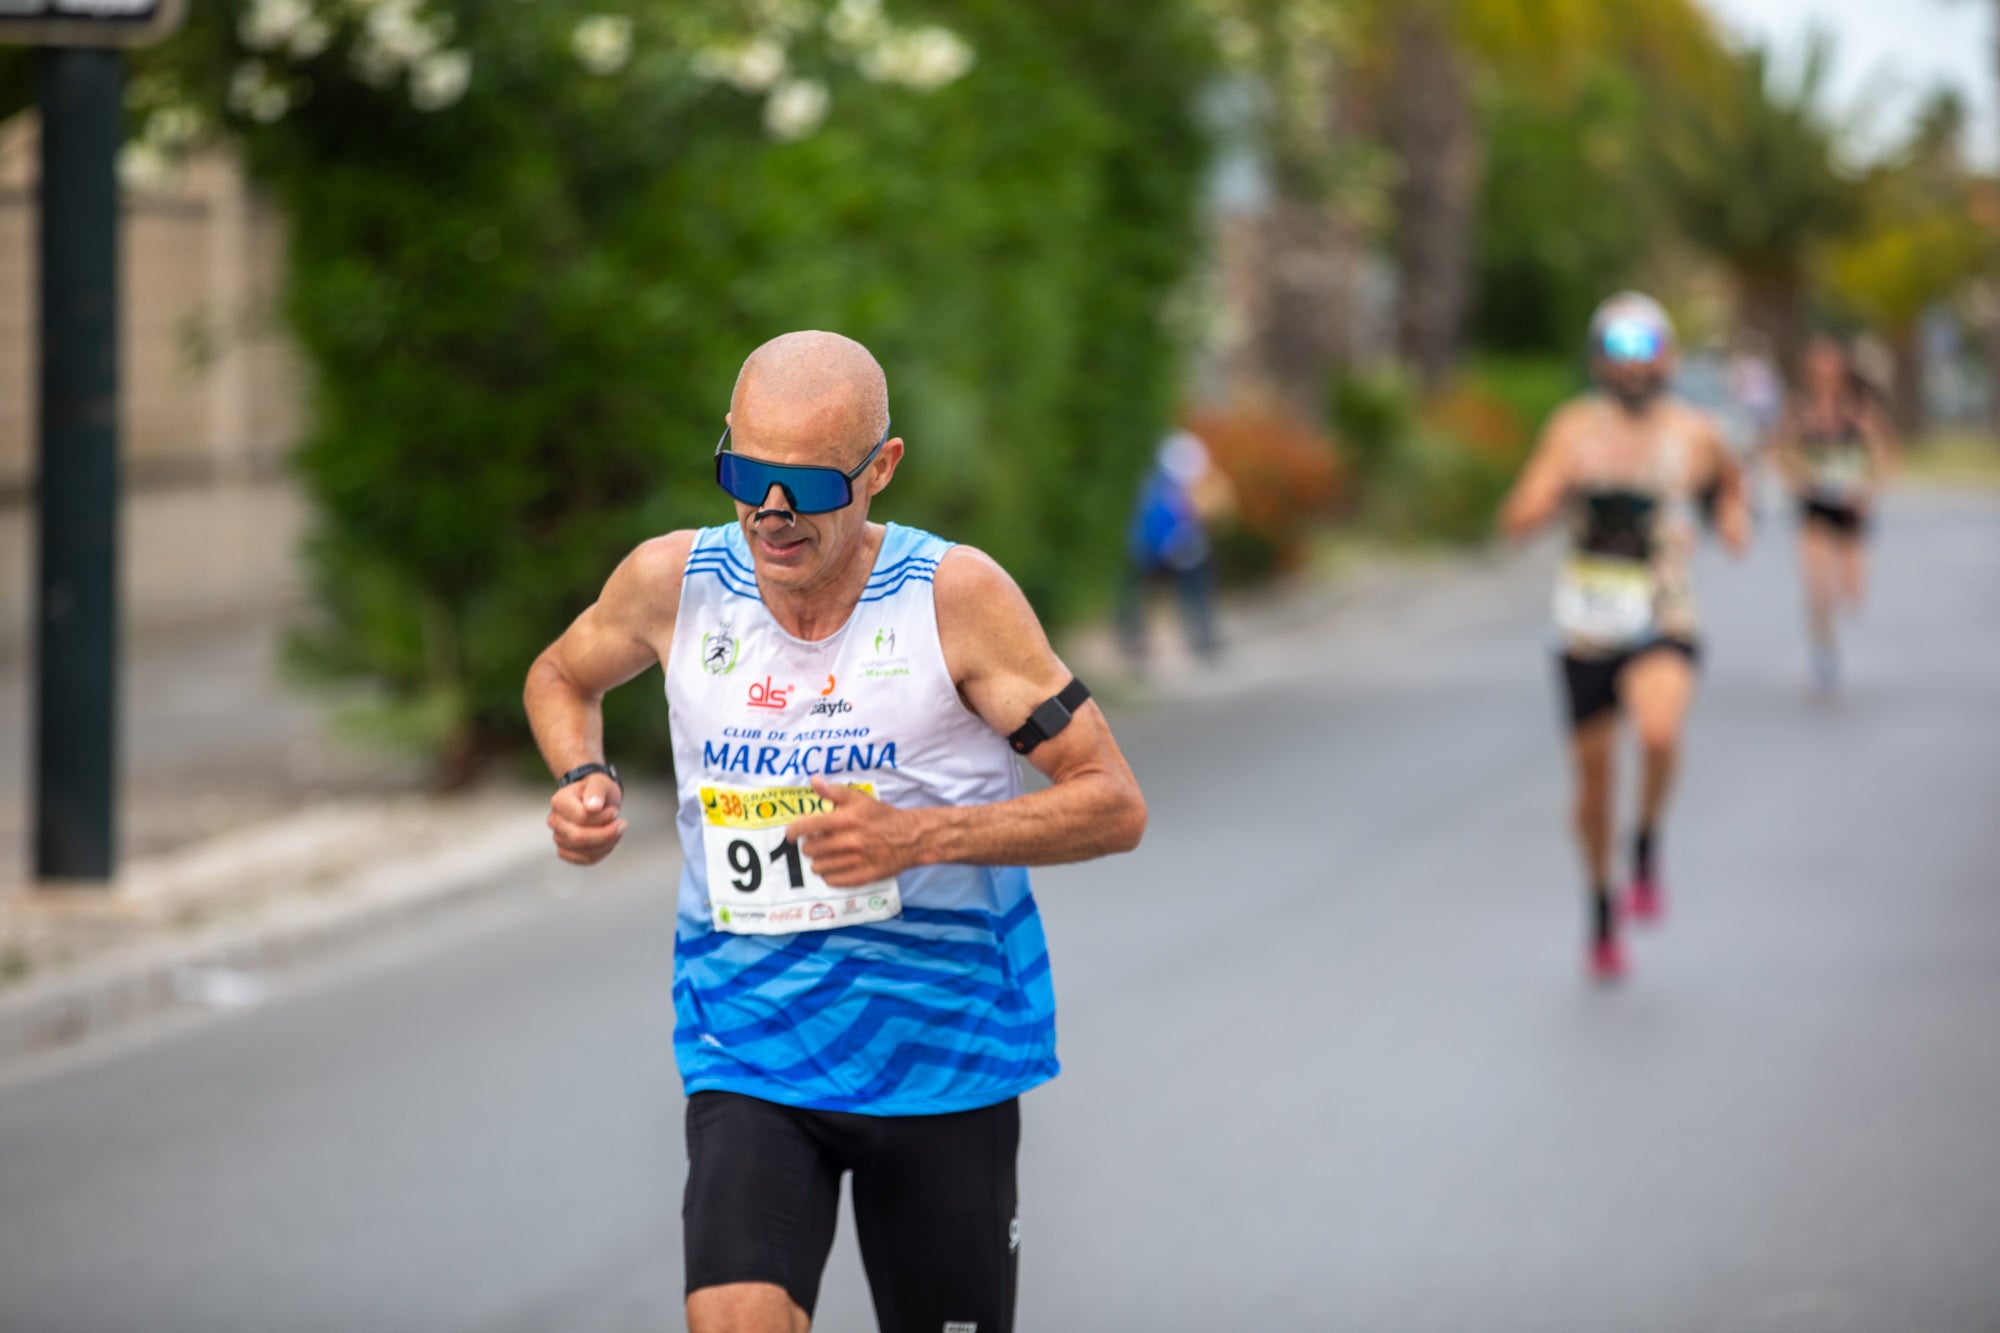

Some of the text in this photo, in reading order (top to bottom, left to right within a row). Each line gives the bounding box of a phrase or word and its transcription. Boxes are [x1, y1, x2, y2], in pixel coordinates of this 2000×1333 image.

[723, 727, 762, 739] CLUB
[767, 730, 786, 741] DE
[703, 740, 898, 776] MARACENA
[781, 786, 815, 797] PREM
[719, 793, 743, 818] 38
